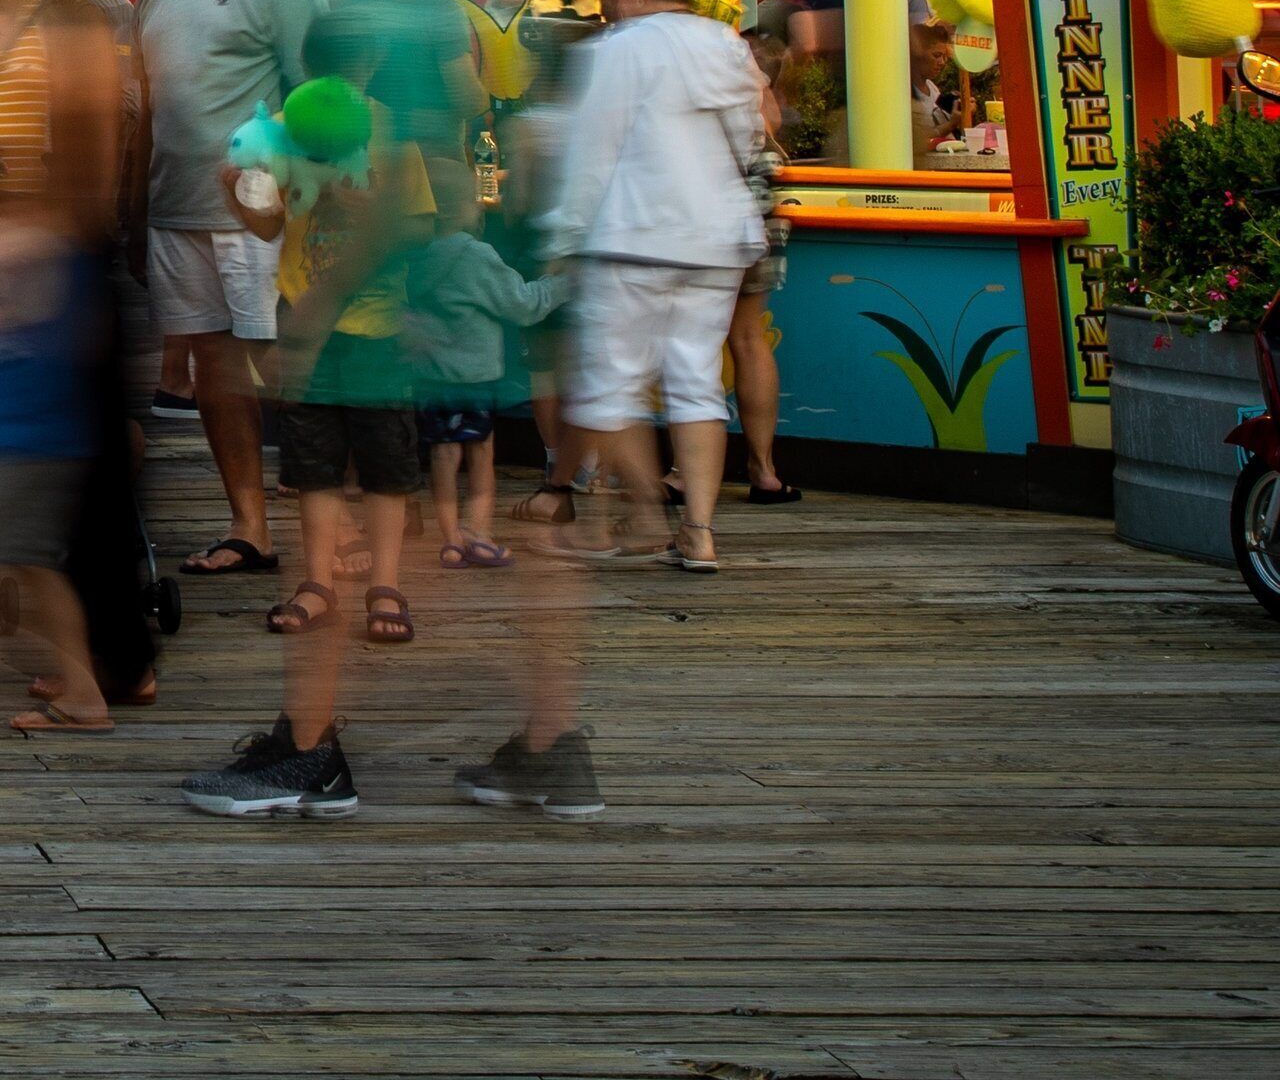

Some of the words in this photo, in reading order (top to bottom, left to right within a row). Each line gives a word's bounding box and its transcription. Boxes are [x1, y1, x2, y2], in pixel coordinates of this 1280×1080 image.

[955, 34, 992, 50] LARGE
[865, 193, 900, 205] PRIZES:
[1062, 177, 1124, 207] Every
